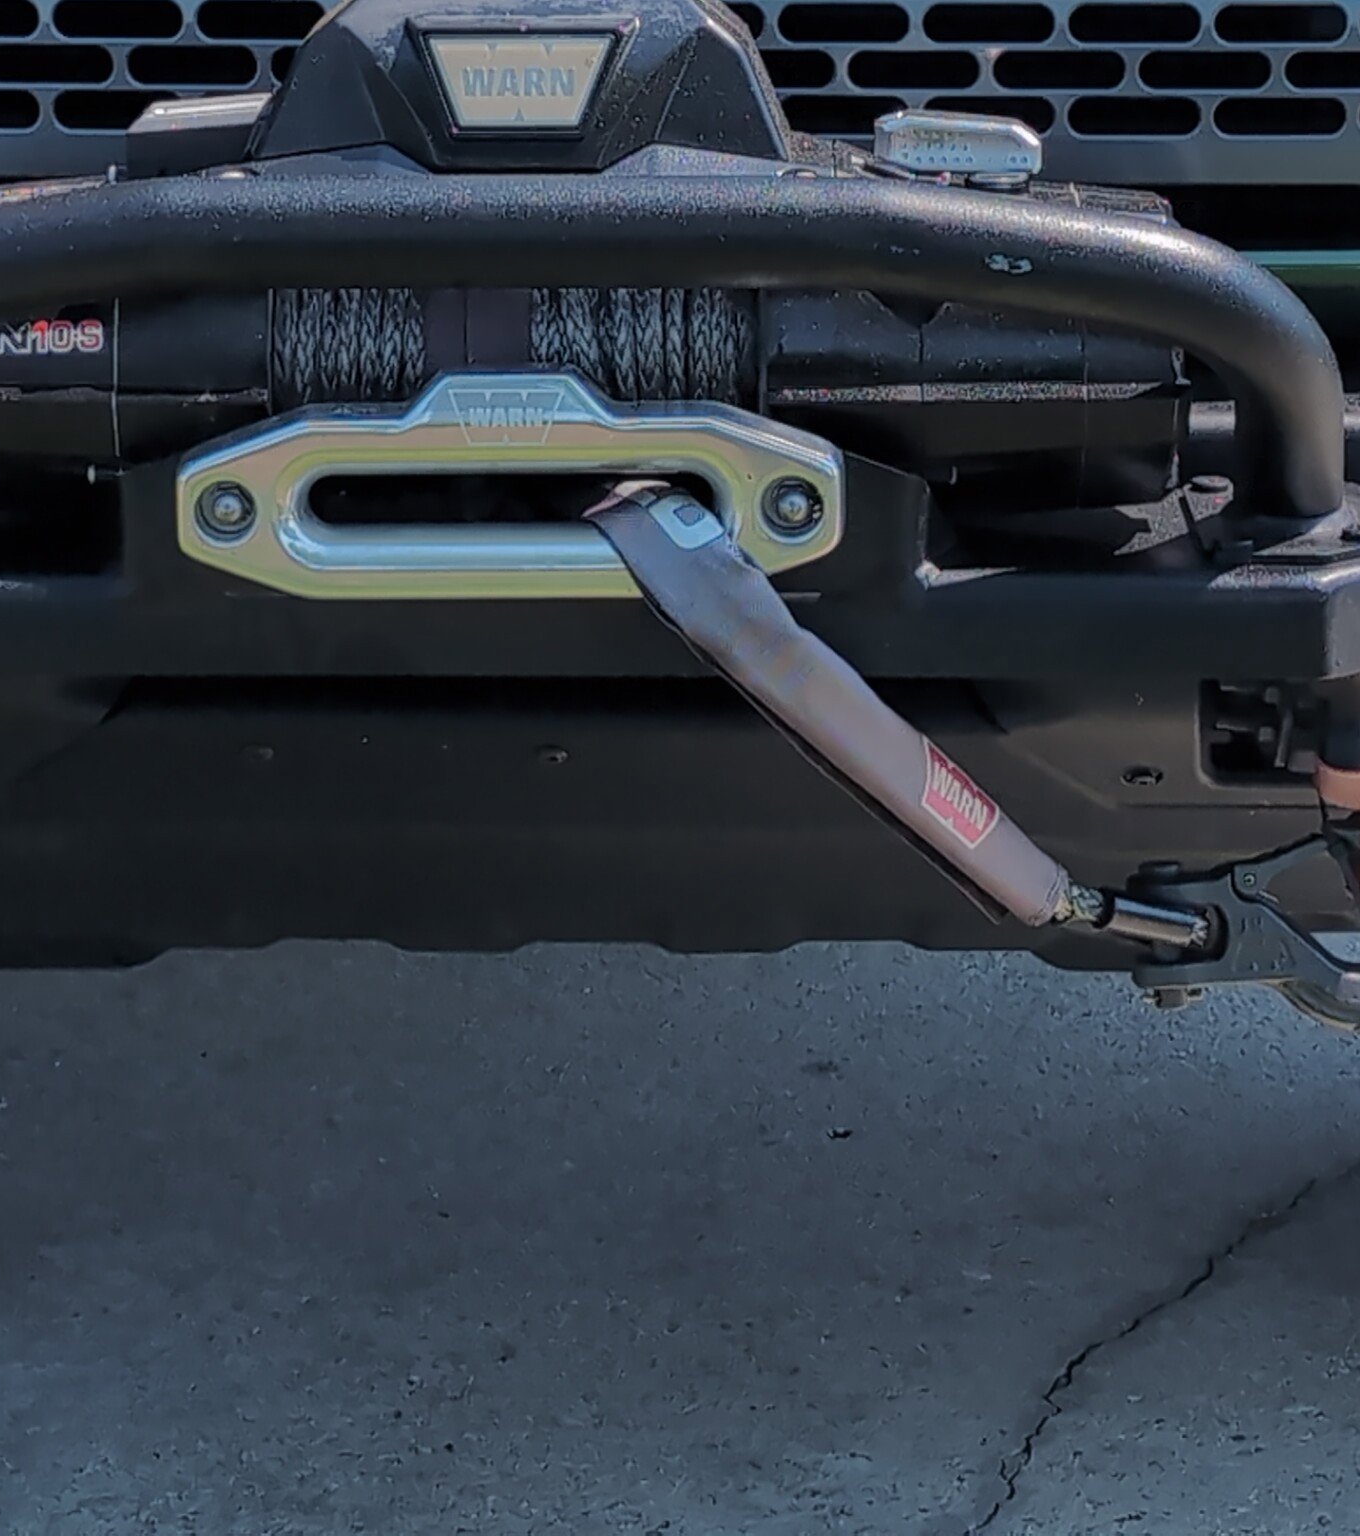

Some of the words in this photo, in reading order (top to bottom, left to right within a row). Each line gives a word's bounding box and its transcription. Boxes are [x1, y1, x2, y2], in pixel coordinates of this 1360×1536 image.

[461, 65, 576, 98] WARN
[467, 407, 544, 428] WARN
[931, 762, 989, 832] WARN
